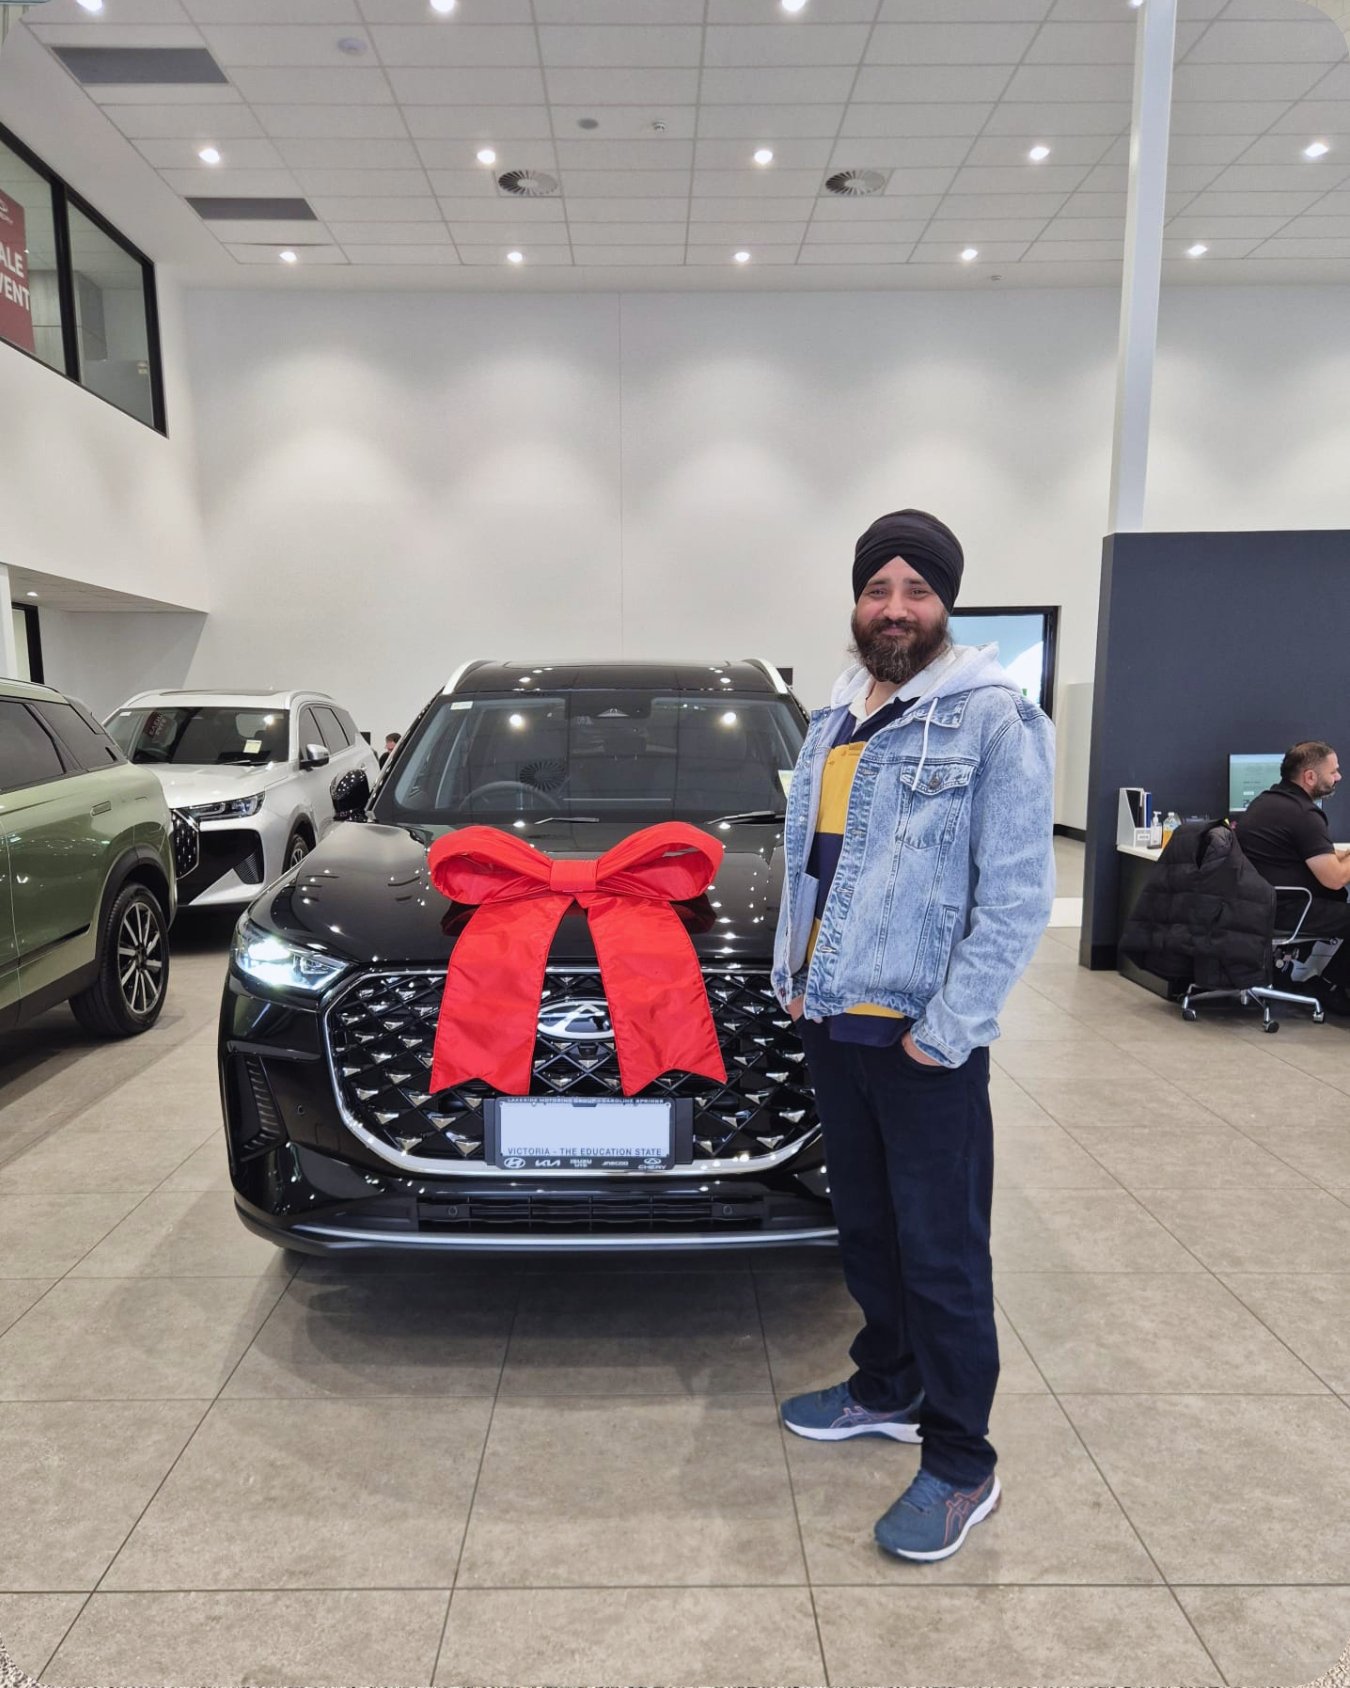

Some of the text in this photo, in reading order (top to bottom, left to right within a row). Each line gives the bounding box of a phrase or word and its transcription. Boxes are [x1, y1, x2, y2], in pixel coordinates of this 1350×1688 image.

[507, 1147, 550, 1155] VICTORIA
[560, 1147, 577, 1155] THE
[580, 1147, 632, 1156] EDUCATION
[635, 1147, 662, 1156] STATE
